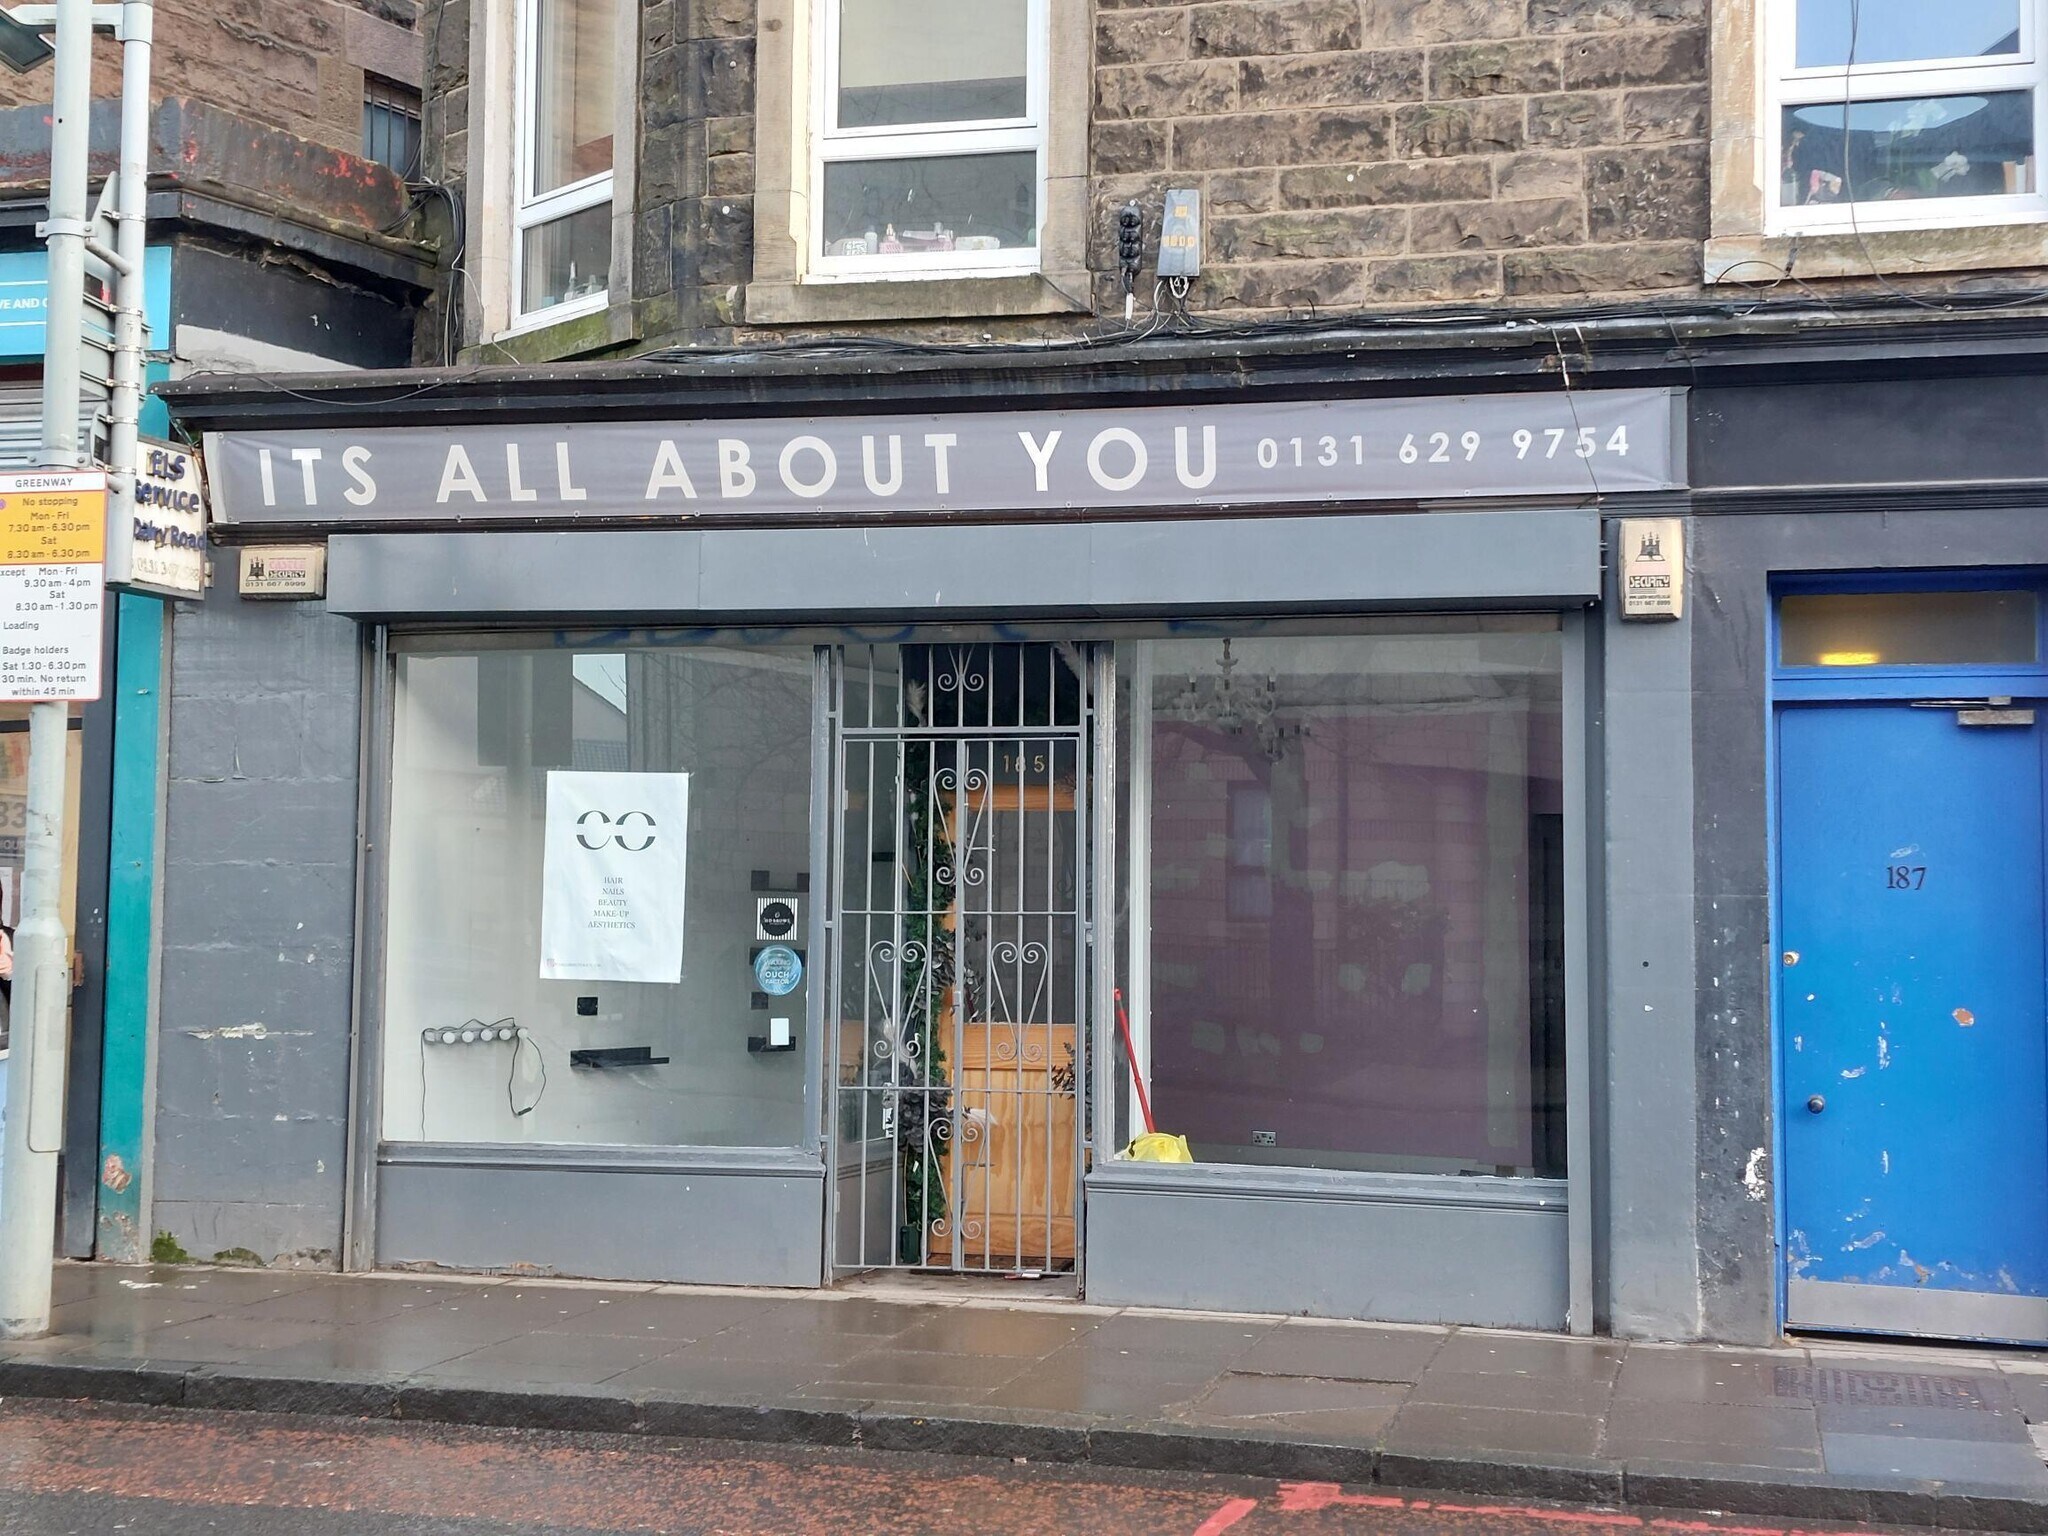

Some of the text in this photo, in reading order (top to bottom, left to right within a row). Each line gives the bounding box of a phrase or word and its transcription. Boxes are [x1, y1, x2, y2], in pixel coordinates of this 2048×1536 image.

[13, 297, 40, 309] AND
[259, 424, 1630, 506] ITS ALL ABOUT YOU 0131 629 9754
[15, 478, 73, 488] GREENWAY
[22, 497, 78, 506] No stopping
[30, 512, 50, 520] Mon
[57, 511, 70, 520] Fri
[9, 523, 30, 532] 7.30
[52, 522, 75, 531] 6.30
[76, 524, 90, 532] pm
[41, 536, 57, 545] Sat
[170, 525, 207, 551] Road
[7, 550, 30, 559] 8.30
[52, 549, 74, 558] 6.30
[76, 550, 90, 558] pm
[38, 567, 58, 576] Mon
[65, 566, 78, 575] Fri
[24, 579, 47, 588] 9.30
[1629, 574, 1671, 588] SECURITY
[49, 591, 66, 599] Sat
[15, 602, 38, 611] 8.30
[60, 601, 83, 610] 1.30
[84, 603, 98, 611] pm
[3, 621, 40, 631] Loading
[2, 645, 70, 656] Badge holders
[2, 662, 19, 670] Sat
[21, 661, 42, 670] 1.30
[48, 661, 71, 670] 6.30
[1, 674, 87, 683] 30 min. No return
[11, 687, 76, 696] within 45 min
[576, 810, 657, 852] CO
[604, 876, 624, 885] HAIR
[1886, 865, 1928, 891] 187
[602, 887, 625, 896] NAILS
[598, 898, 628, 907] BEAUTY
[593, 909, 630, 918] MAKE-UP
[587, 920, 636, 930] AESTHETICS
[765, 970, 790, 979] OUCH
